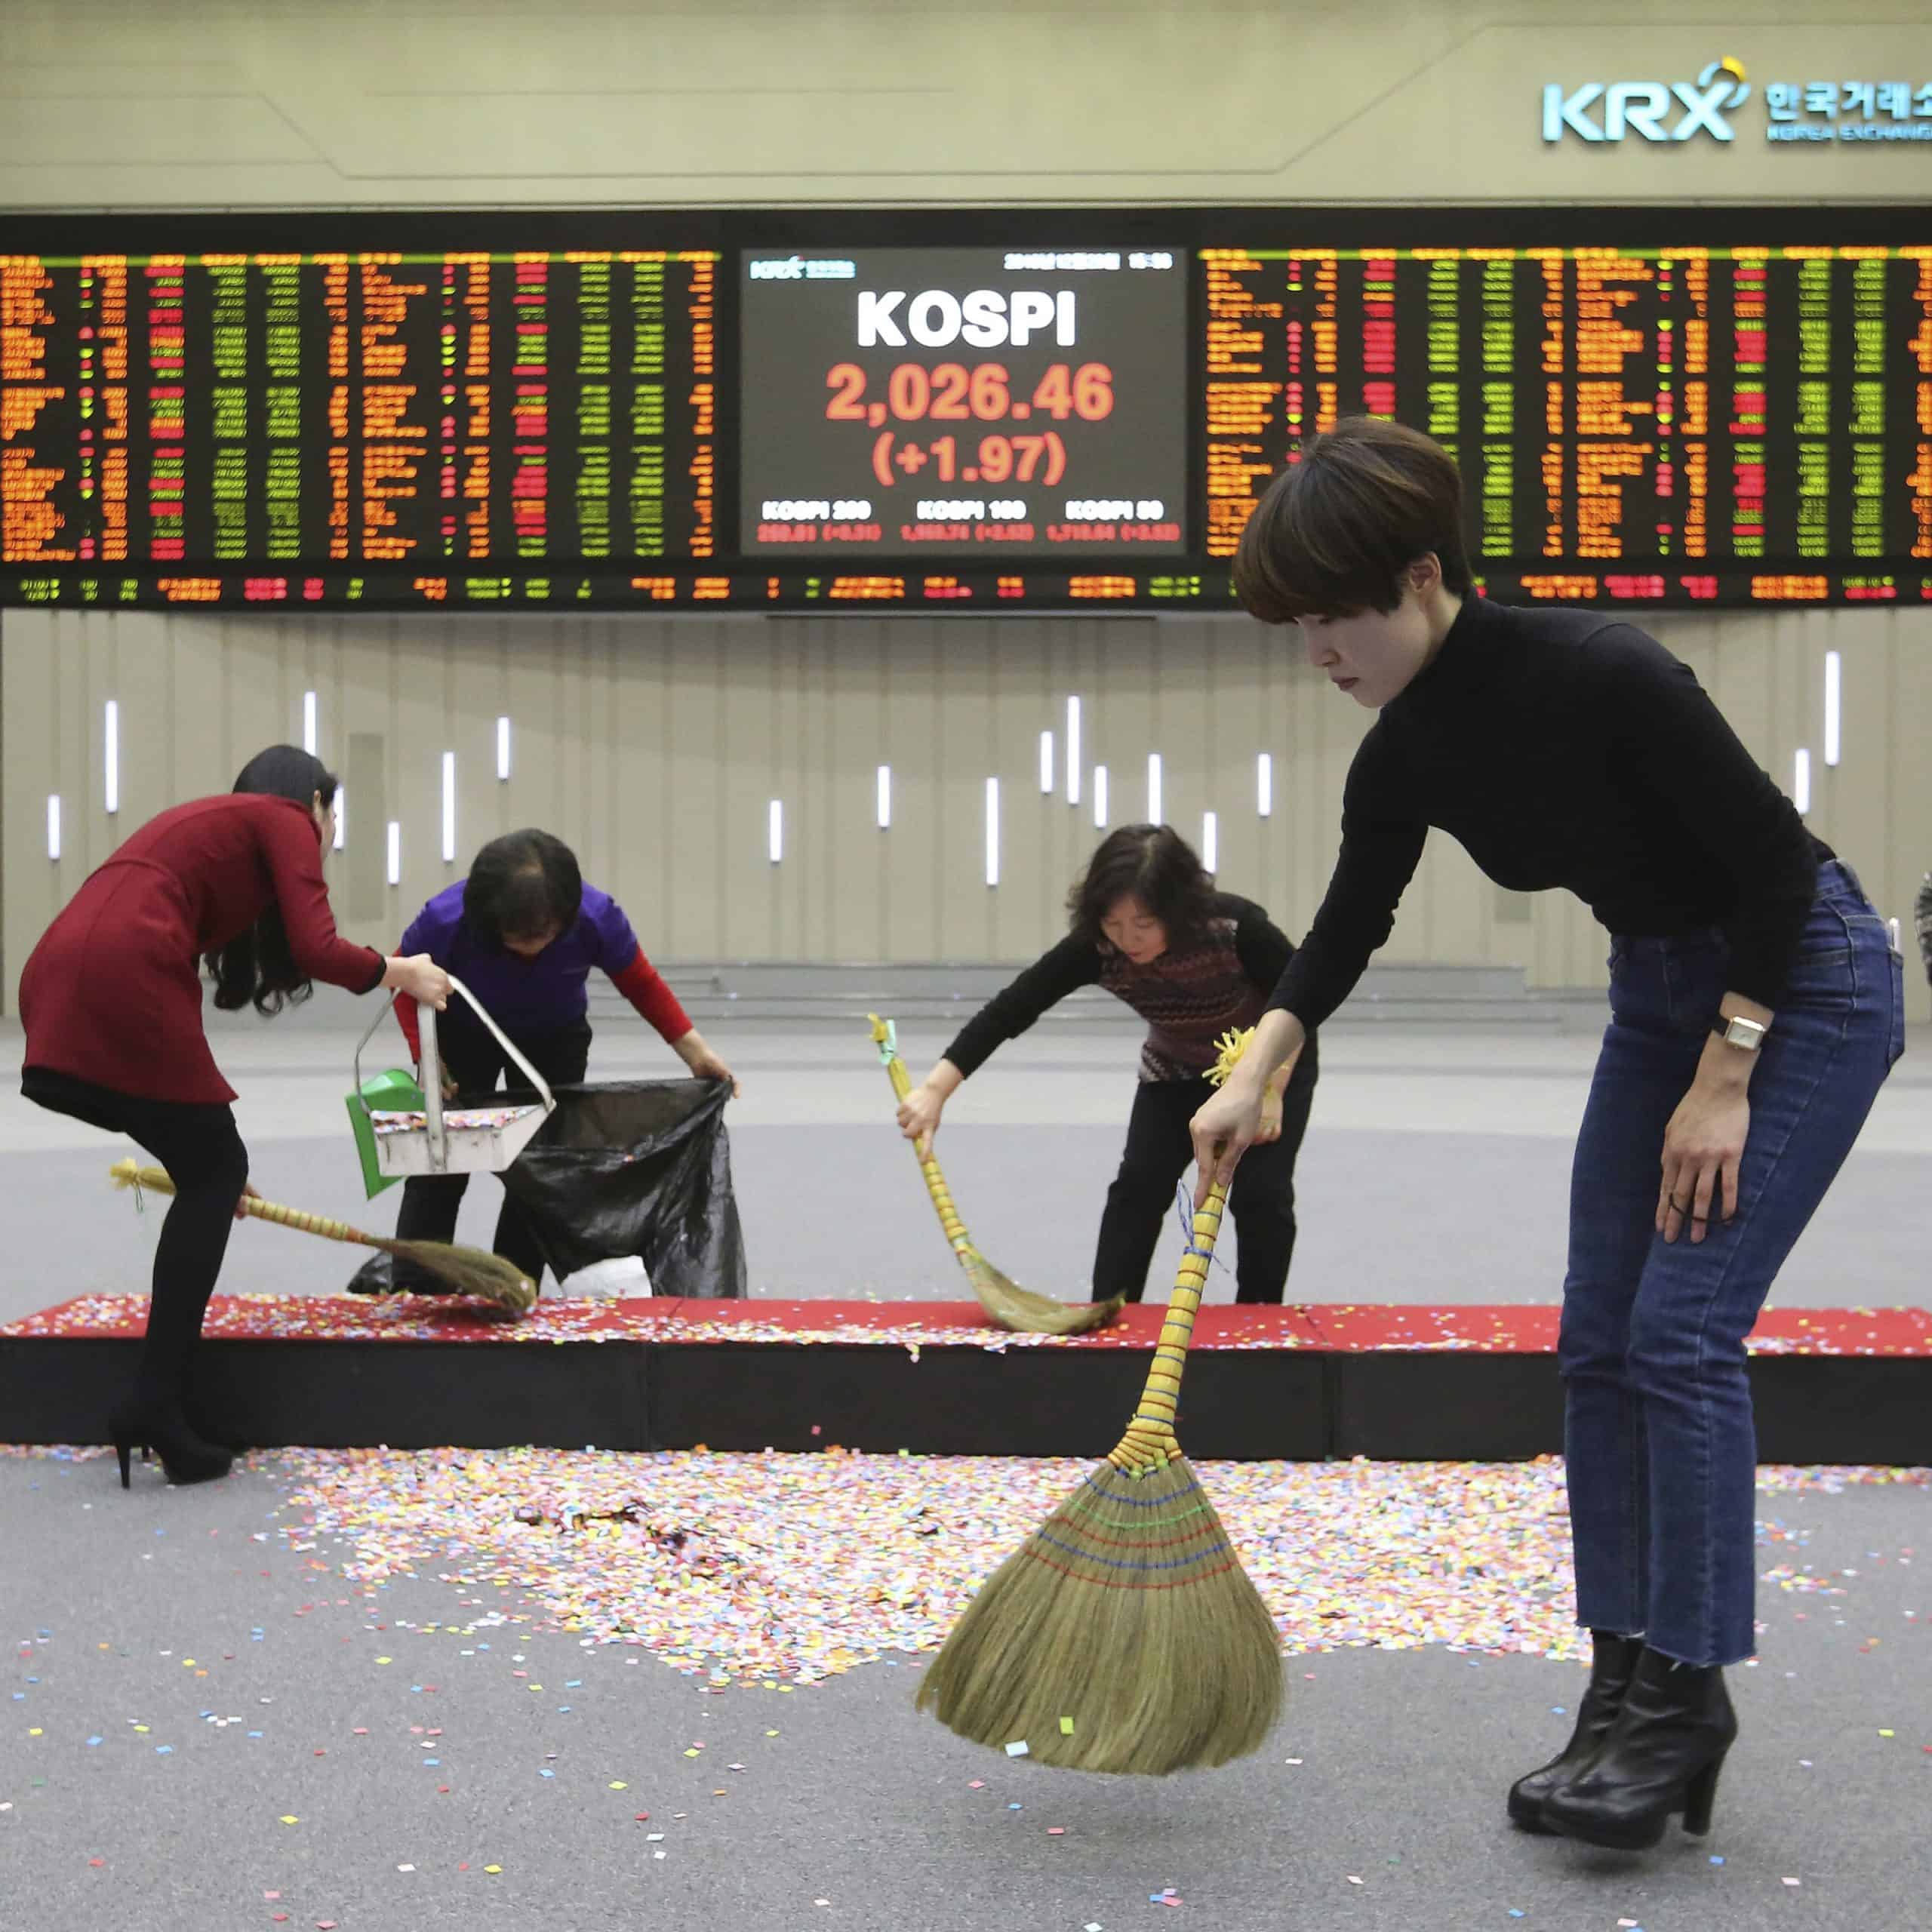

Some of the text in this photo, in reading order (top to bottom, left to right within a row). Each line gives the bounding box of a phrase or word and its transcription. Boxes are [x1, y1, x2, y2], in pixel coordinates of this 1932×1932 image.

[1543, 74, 1744, 142] KRX
[1767, 125, 1835, 141] KOREA
[857, 290, 1075, 348] KOSPI
[826, 363, 1114, 427] 2,026.46
[872, 431, 1066, 486] (+1.97)
[762, 500, 829, 521] KOSPI
[917, 500, 984, 521] KOSPI
[1066, 500, 1134, 521] KOSPI
